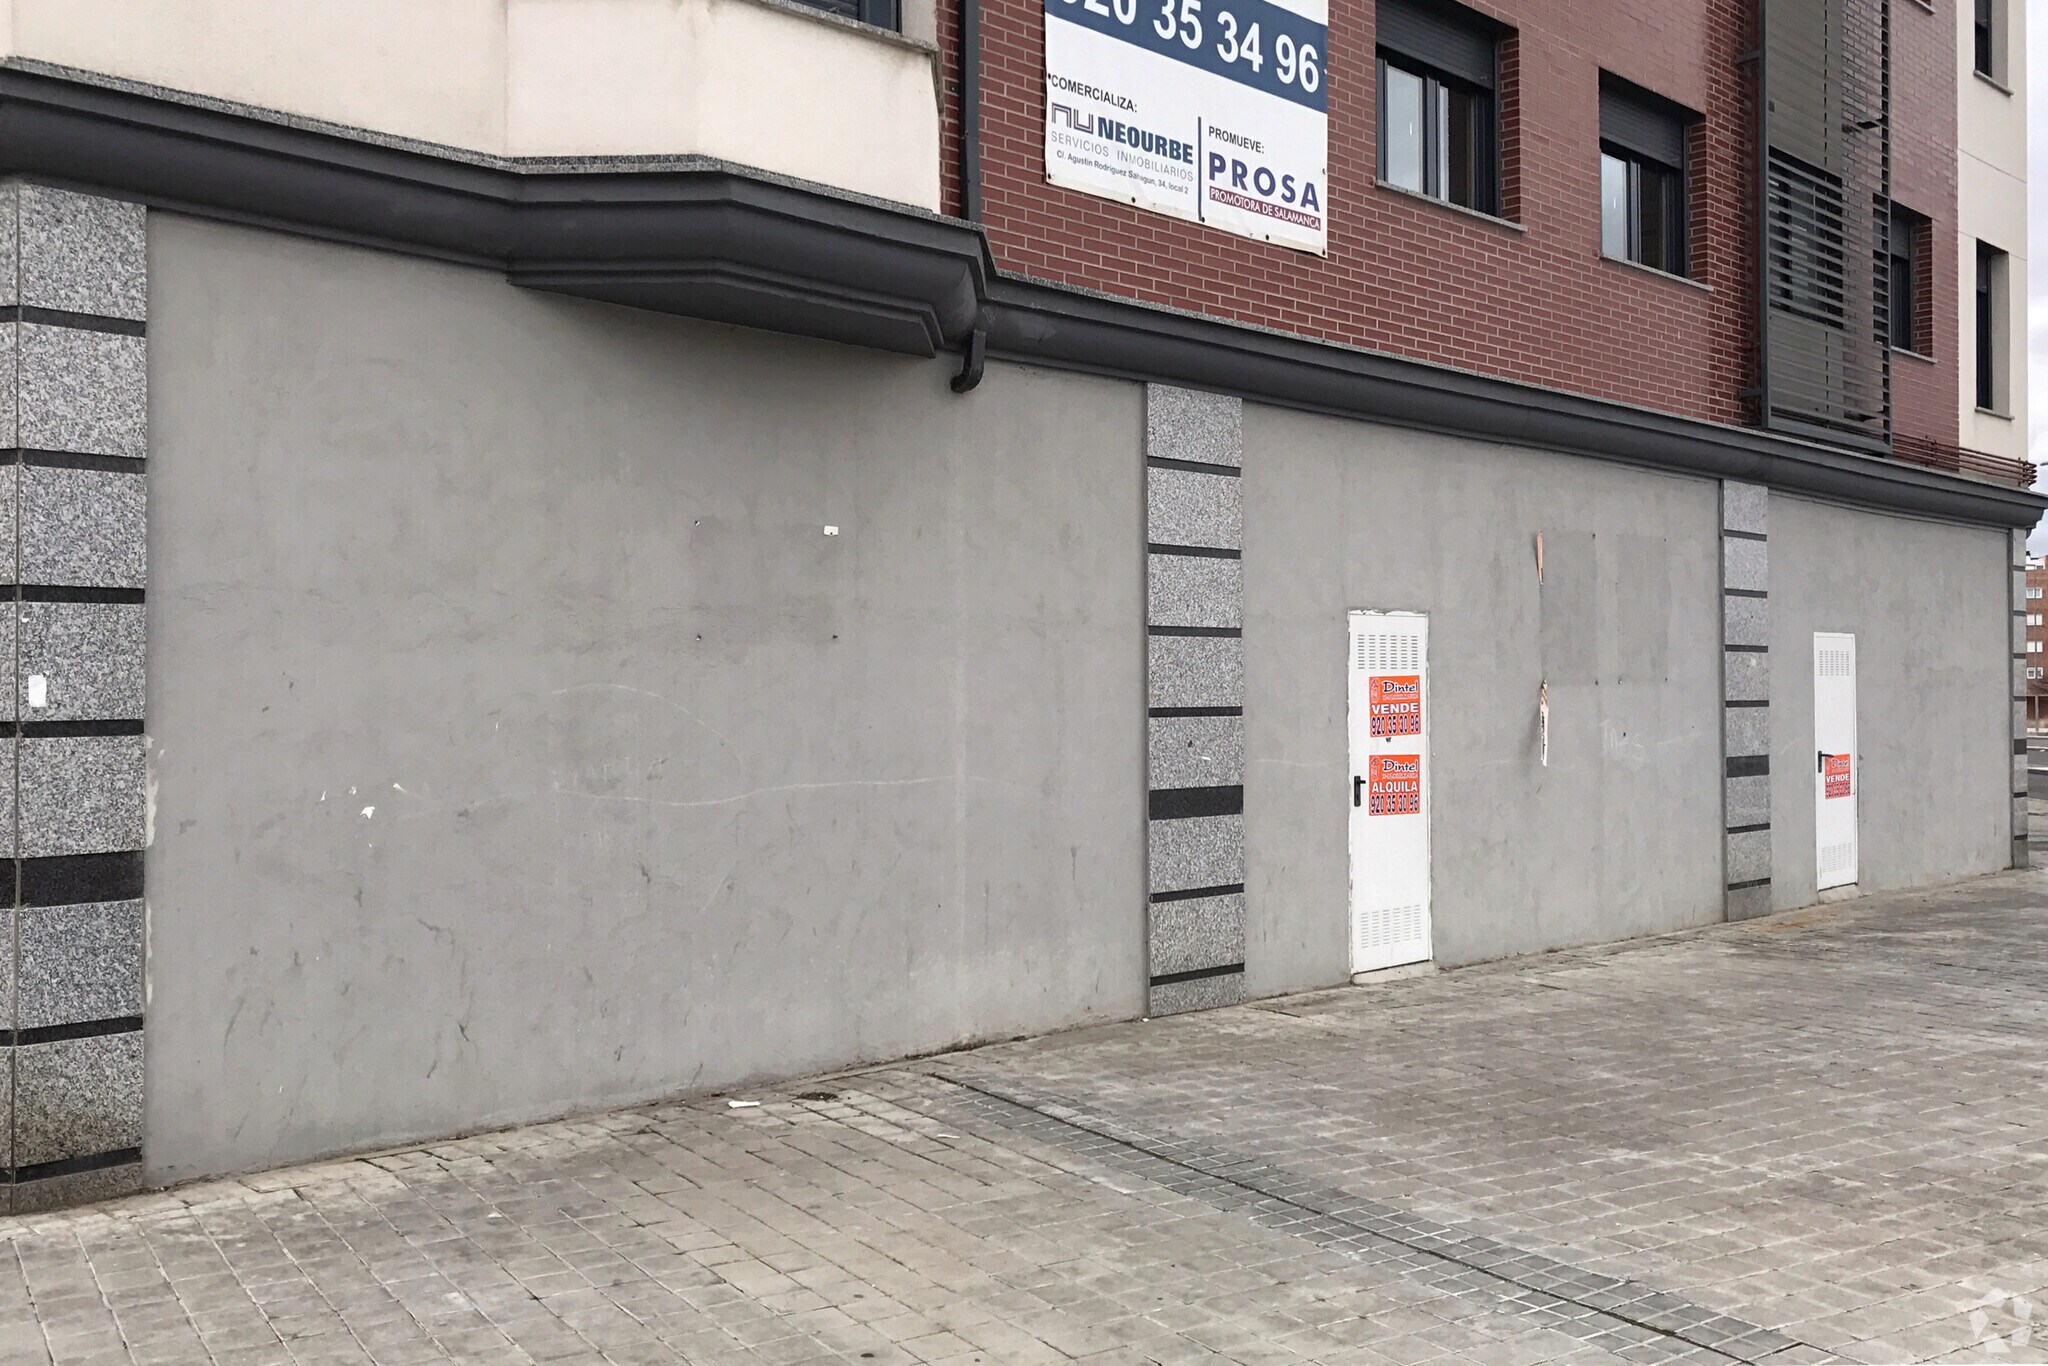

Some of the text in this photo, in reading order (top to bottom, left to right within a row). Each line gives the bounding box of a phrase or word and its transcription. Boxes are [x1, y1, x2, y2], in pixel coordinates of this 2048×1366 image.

[1153, 0, 1202, 49] 35
[1217, 10, 1264, 74] 34
[1275, 34, 1320, 93] 96
[1051, 74, 1138, 114] COMERCIALIZA:
[1097, 116, 1194, 165] NEOURBE
[1208, 125, 1265, 155] PROMUEVE:
[1051, 130, 1194, 182] SERVICIOS INMOBILIARIOS
[1168, 181, 1184, 193] local
[1184, 186, 1189, 195] 2
[1208, 151, 1321, 213] PROSA
[1209, 188, 1320, 230] PROMOTORA DE SALAMANCA
[1382, 679, 1418, 693] Dintel
[1371, 702, 1419, 715] VENDE
[1371, 716, 1386, 735] 920
[1388, 715, 1397, 734] 35
[1410, 713, 1420, 732] 96
[1382, 758, 1418, 772] Dintel
[1371, 780, 1419, 793] ALQUILA
[1825, 773, 1850, 783] VENDE
[1371, 795, 1385, 813] 920
[1387, 794, 1396, 812] 35
